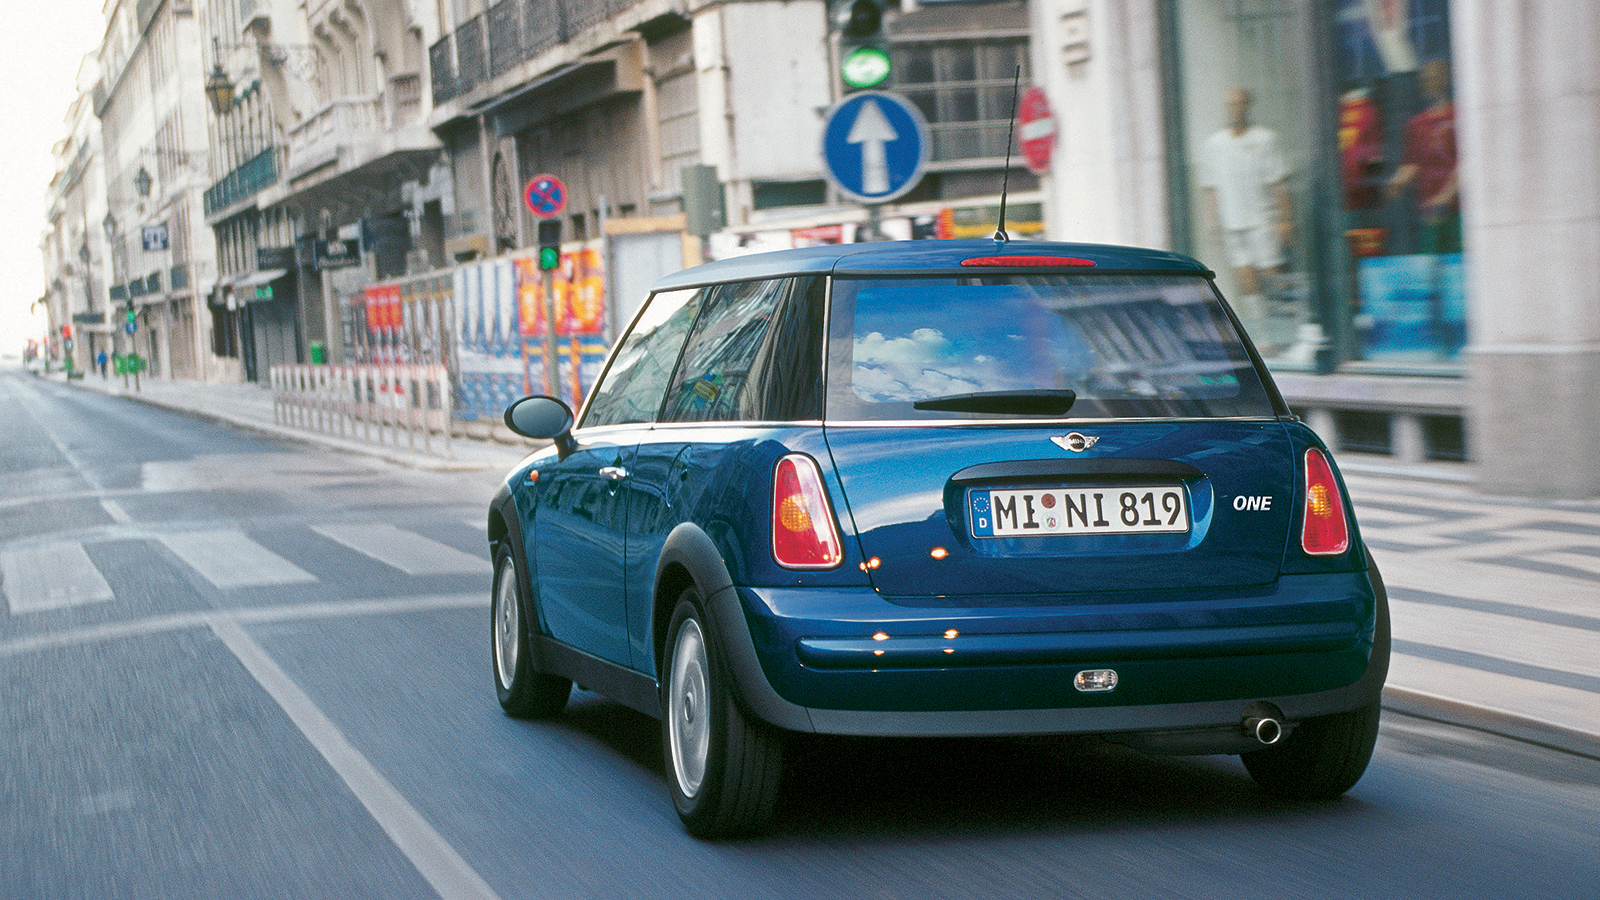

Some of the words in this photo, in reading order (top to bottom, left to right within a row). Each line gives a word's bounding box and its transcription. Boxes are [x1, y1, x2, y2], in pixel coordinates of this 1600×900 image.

[1065, 493, 1109, 527] NI
[1119, 492, 1181, 526] 819
[1233, 495, 1272, 511] ONE
[978, 517, 988, 529] D
